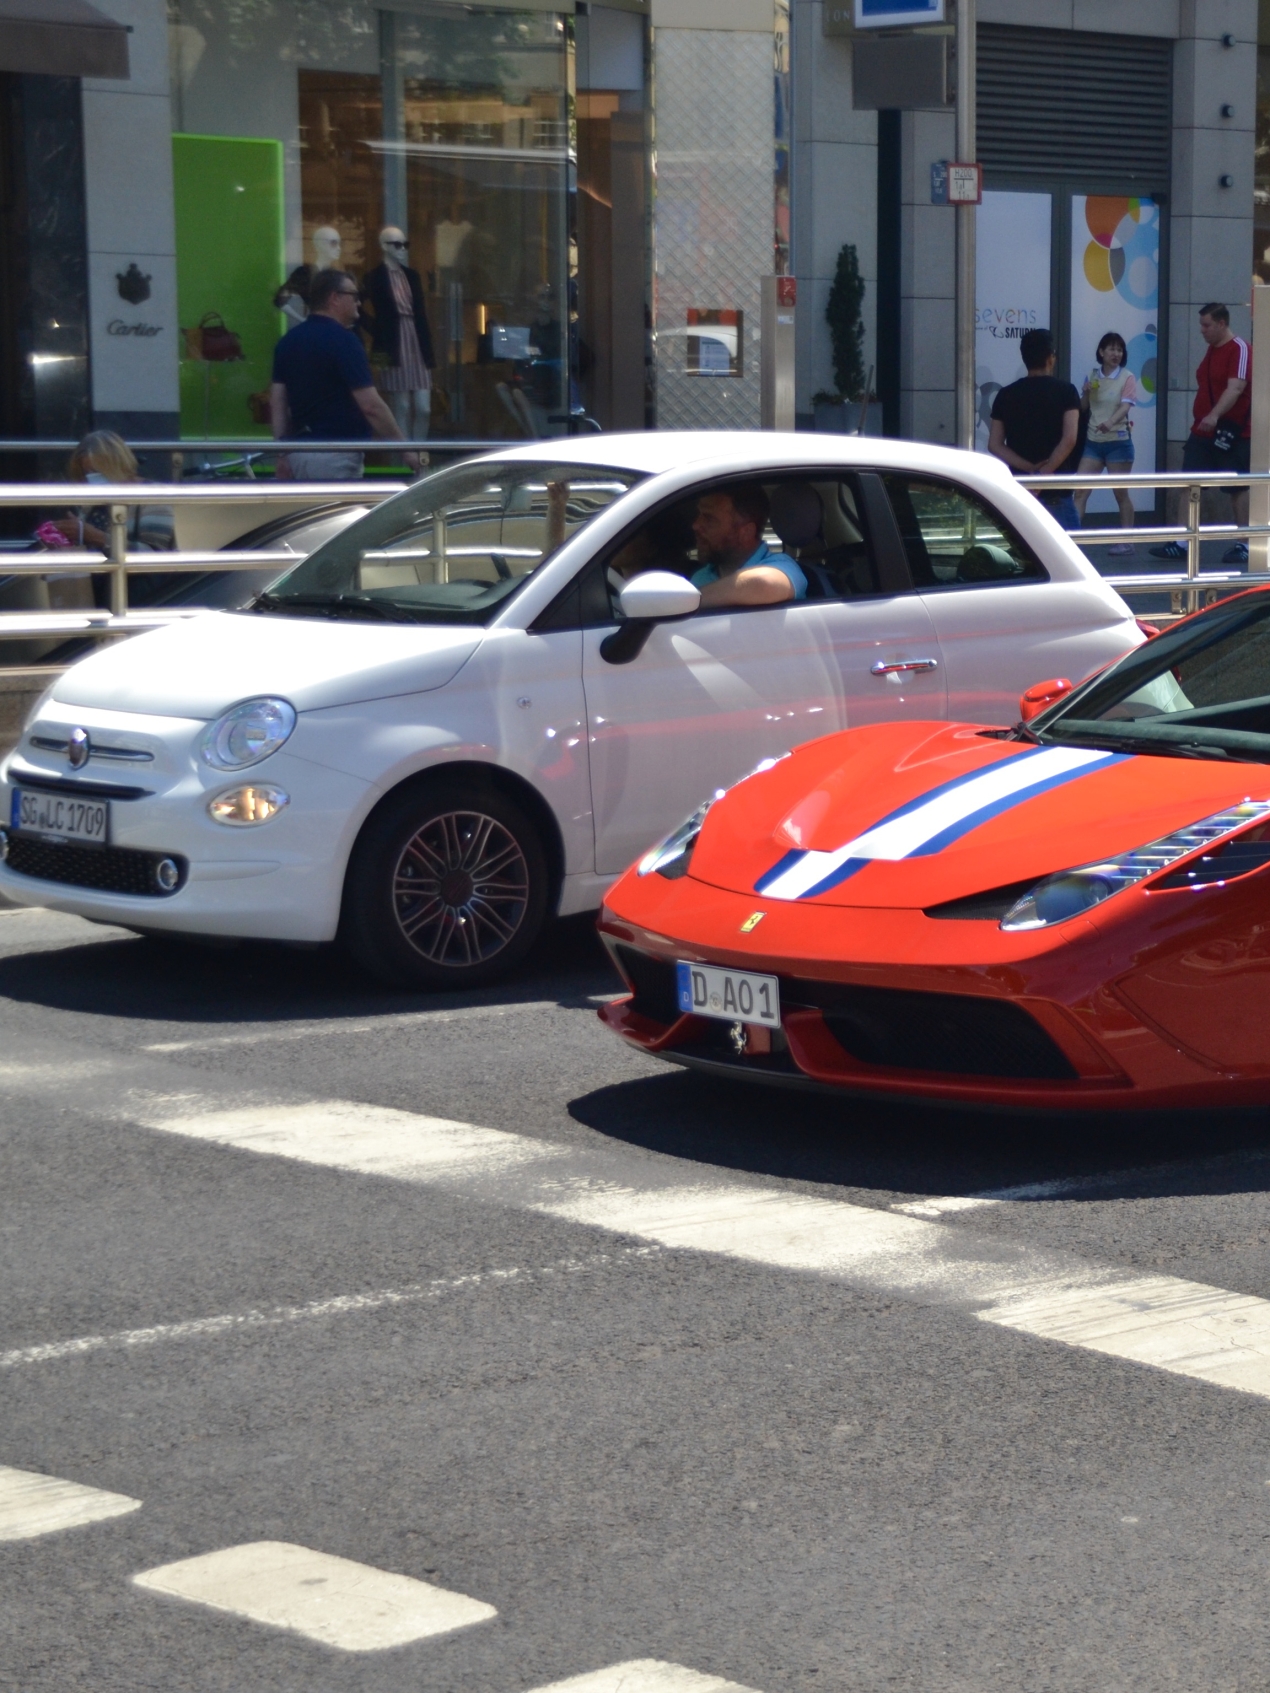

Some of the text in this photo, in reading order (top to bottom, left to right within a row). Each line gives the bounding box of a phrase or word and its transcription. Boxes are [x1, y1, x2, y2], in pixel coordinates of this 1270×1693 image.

[106, 319, 164, 336] Cartier
[21, 796, 37, 826] SG
[68, 803, 104, 836] 1709
[692, 970, 708, 1007] D
[759, 982, 775, 1020] 1
